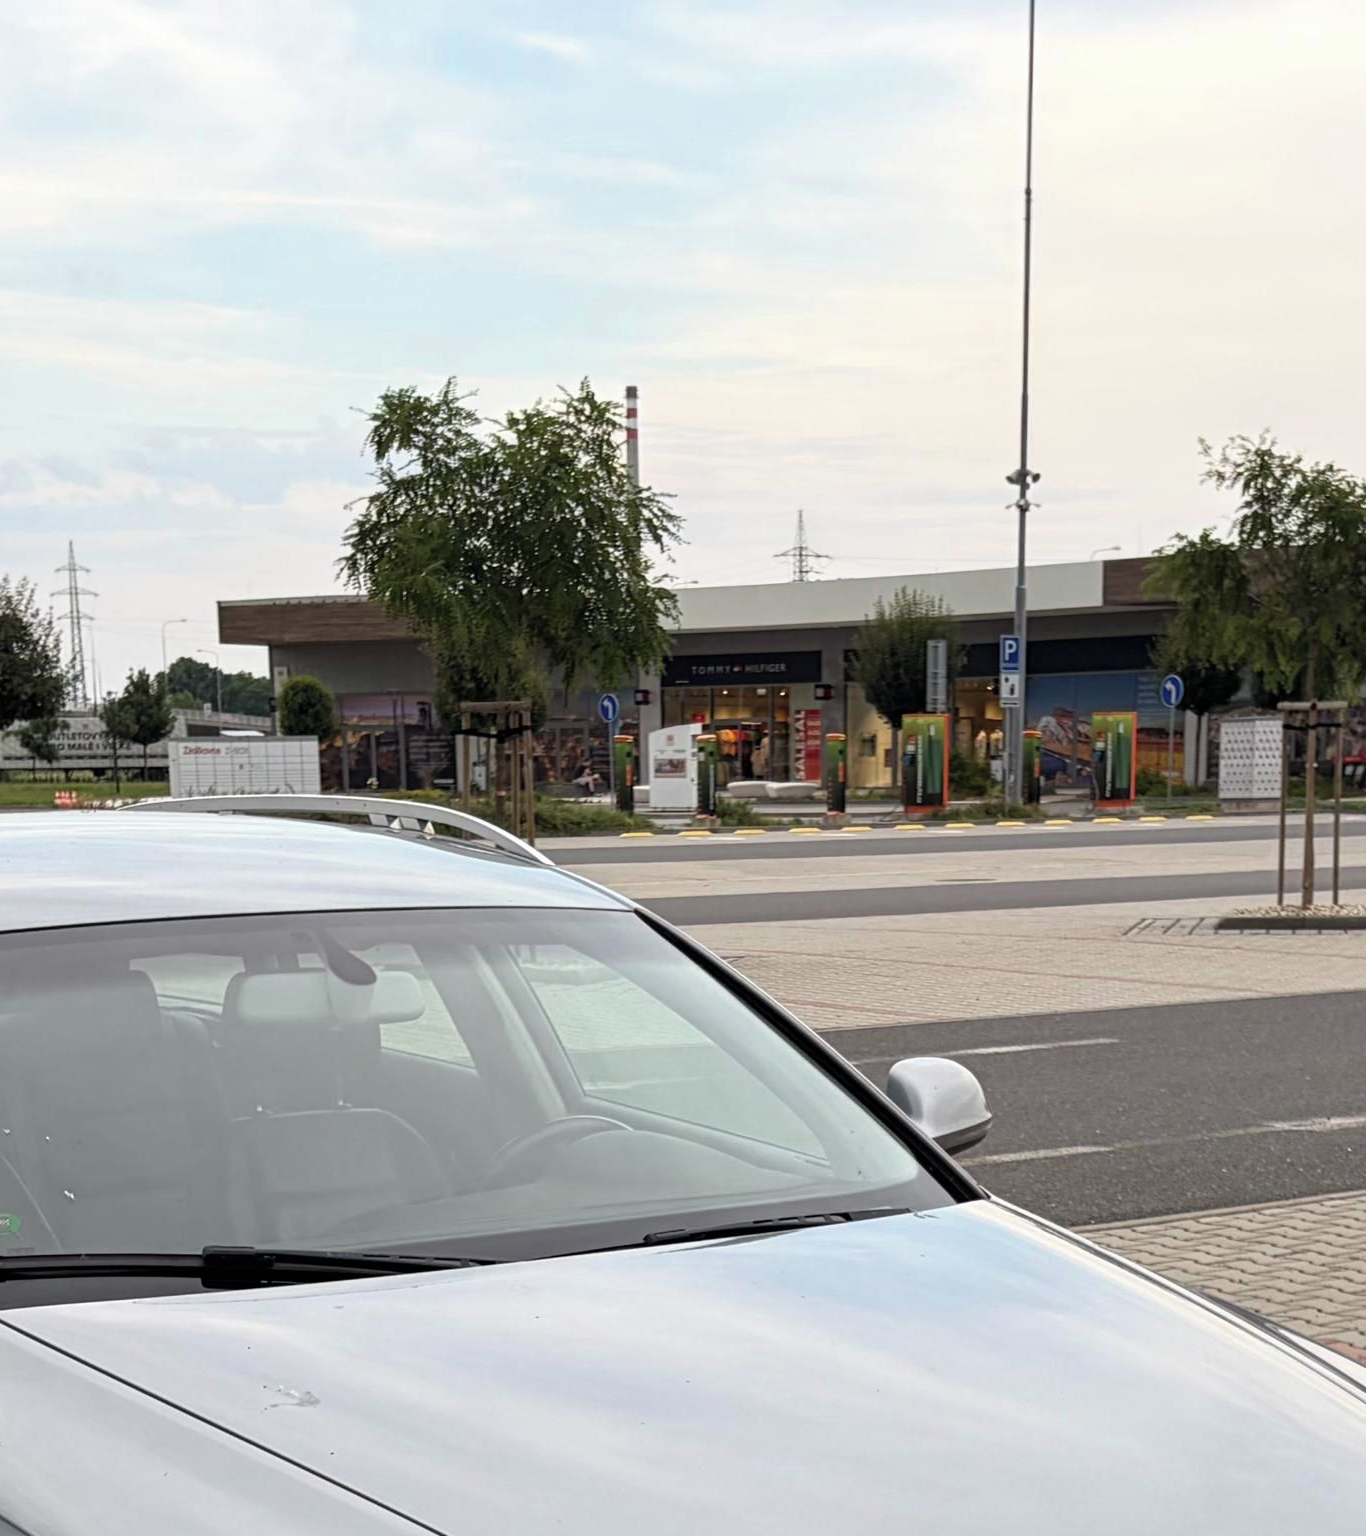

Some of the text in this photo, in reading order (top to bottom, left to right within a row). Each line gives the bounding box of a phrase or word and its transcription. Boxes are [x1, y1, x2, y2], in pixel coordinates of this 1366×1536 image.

[1004, 640, 1017, 661] P
[691, 663, 787, 675] TOMMY HILFIGER
